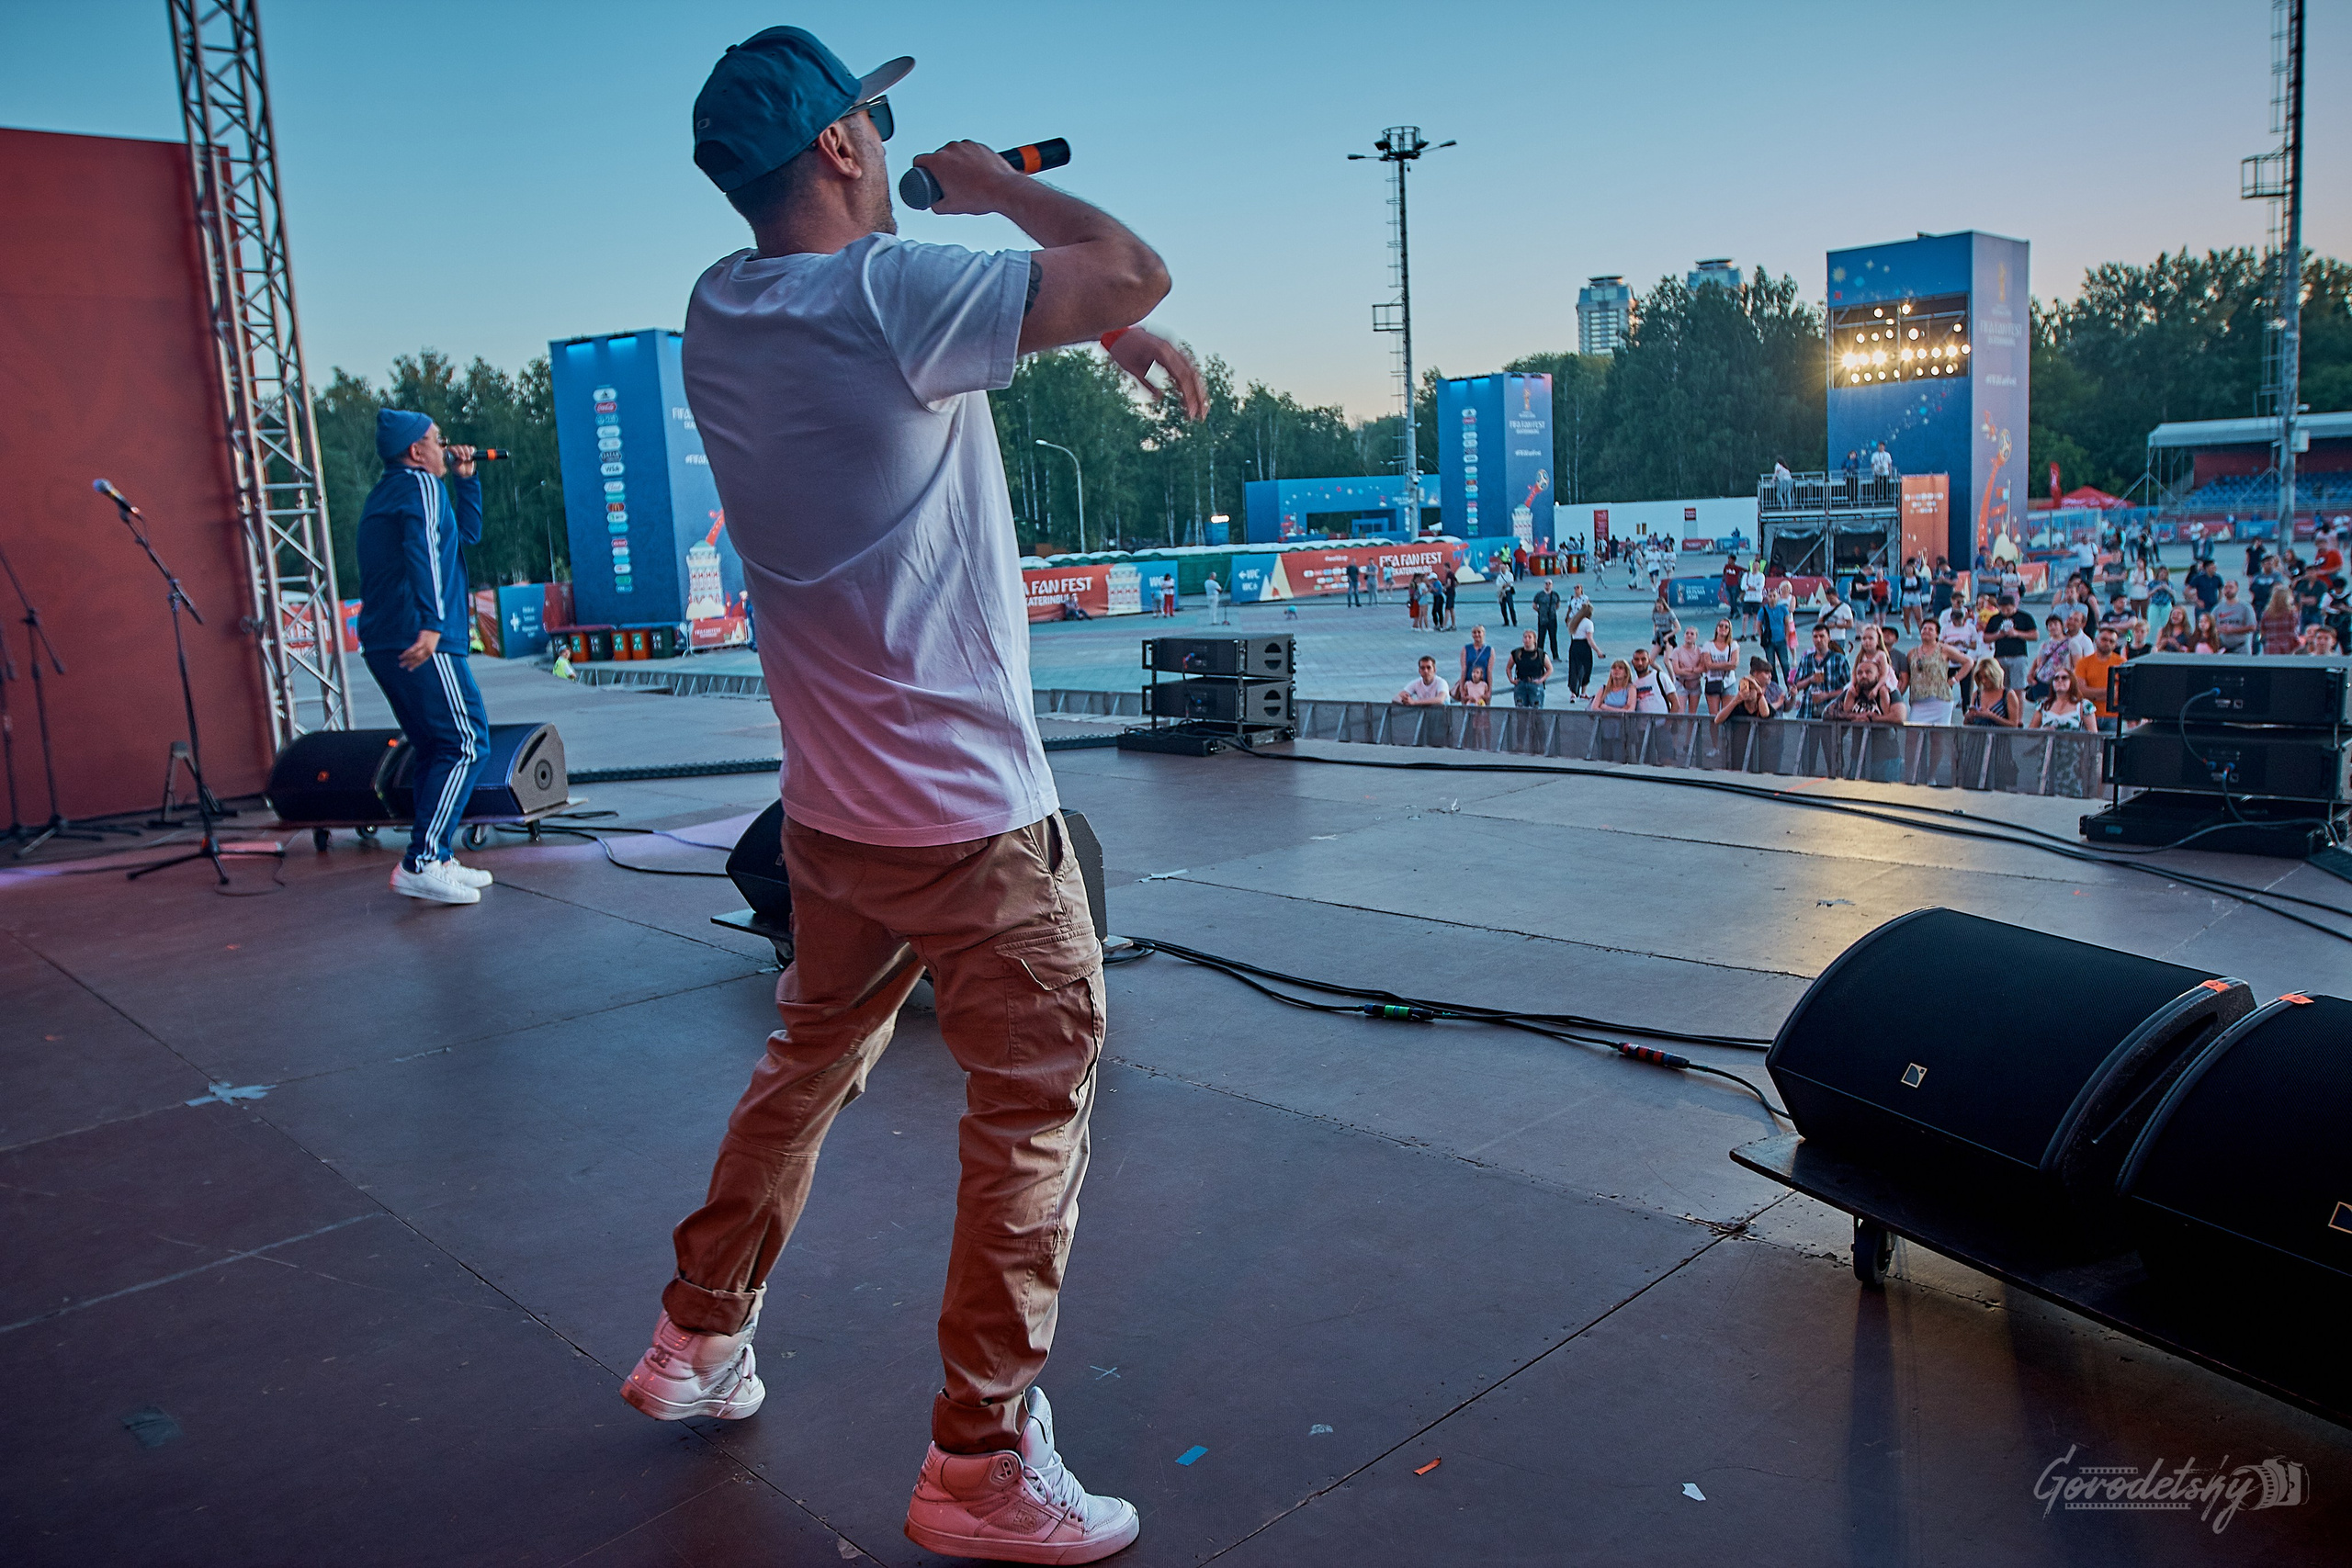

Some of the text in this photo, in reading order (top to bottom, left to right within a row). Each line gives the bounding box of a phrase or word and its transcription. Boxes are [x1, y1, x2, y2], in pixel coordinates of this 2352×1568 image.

[672, 407, 691, 420] FIFA
[1400, 553, 1420, 566] FAN
[1419, 551, 1443, 565] FEST
[1247, 569, 1261, 580] WC
[1031, 579, 1059, 595] FAN
[1060, 576, 1093, 592] FEST
